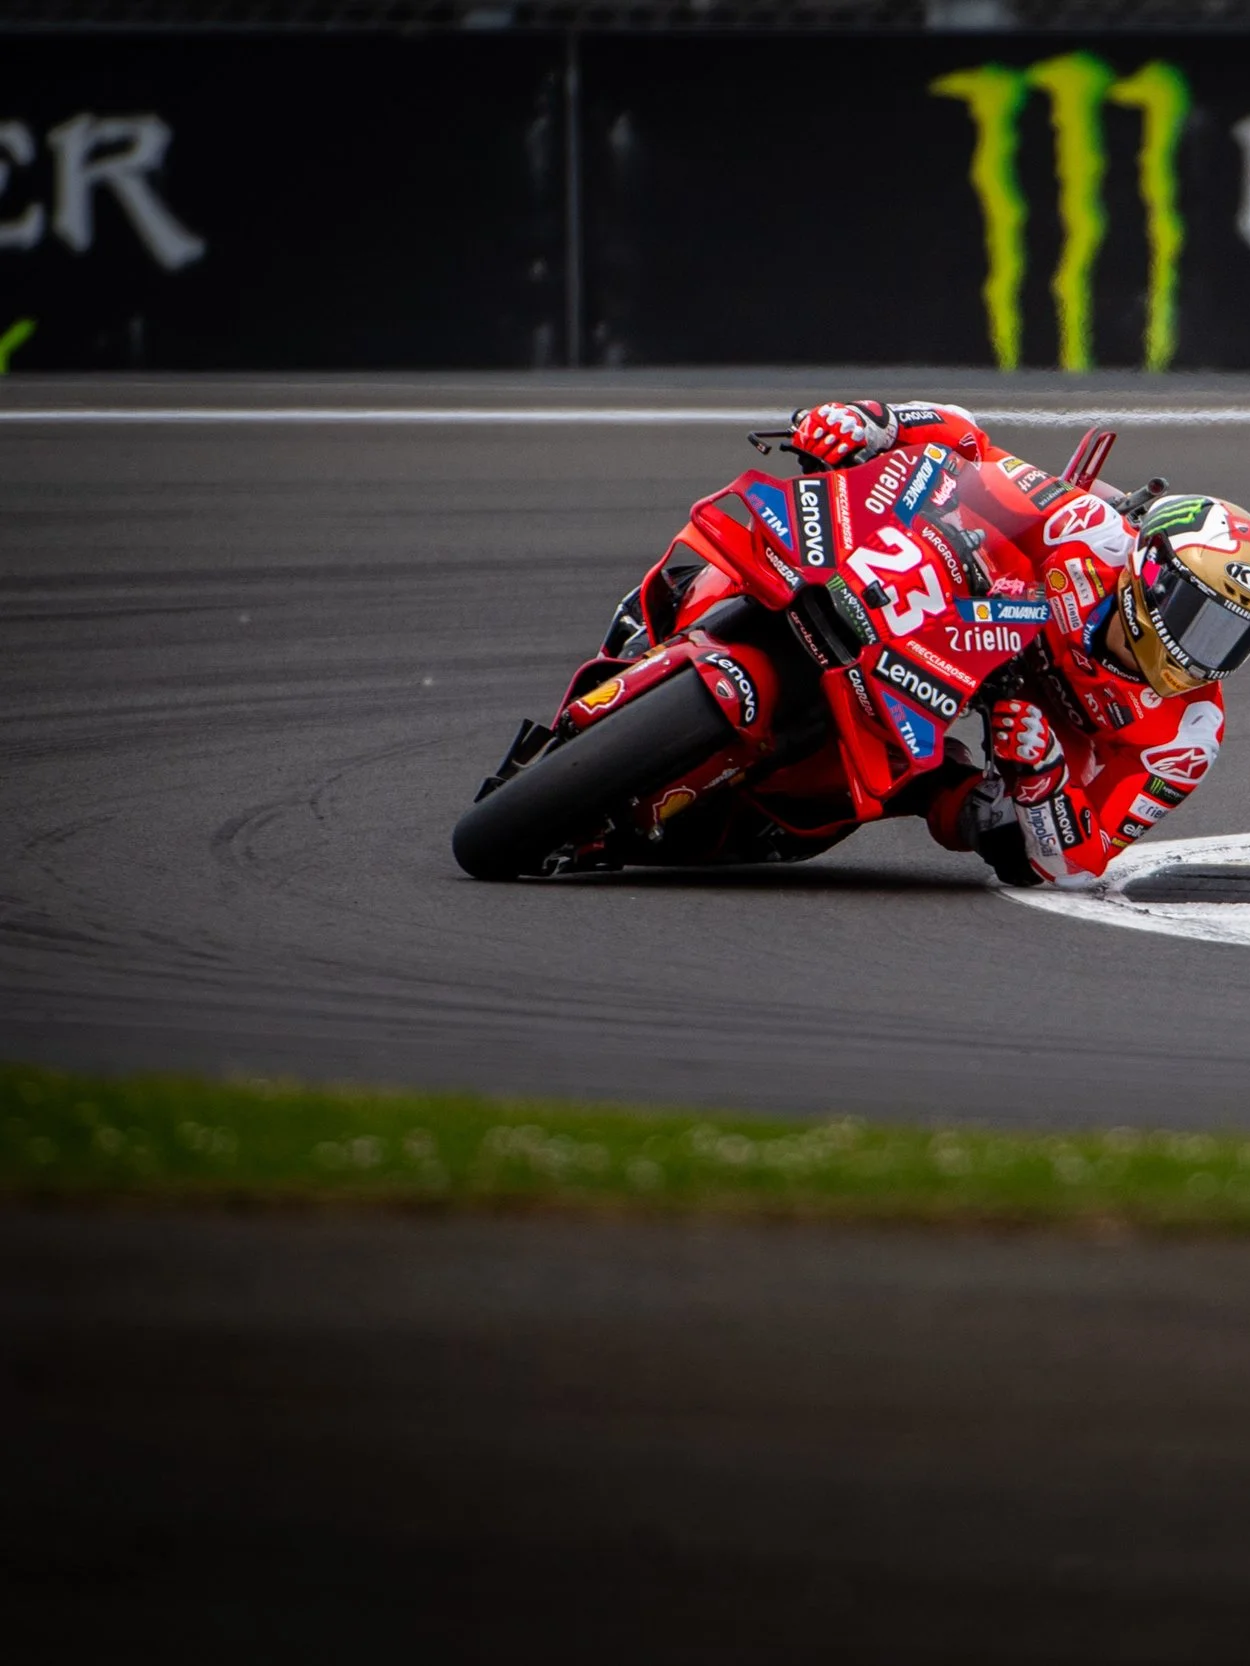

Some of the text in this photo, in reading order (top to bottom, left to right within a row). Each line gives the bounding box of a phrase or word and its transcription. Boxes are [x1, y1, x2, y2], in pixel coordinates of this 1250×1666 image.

[902, 458, 933, 510] ADVANCE
[761, 507, 788, 537] TIM
[799, 480, 825, 566] Lenovo
[837, 474, 853, 550] FRECCIAROSSA
[766, 547, 800, 587] CARRERA
[846, 526, 947, 636] 23
[921, 527, 963, 585] VARGROUP
[841, 588, 877, 644] MONSTER
[998, 604, 1048, 620] ADVANCE
[1083, 623, 1095, 645] TIM
[1123, 585, 1139, 636] Lenovo
[790, 611, 829, 665] aruba.it
[1150, 608, 1190, 667] TERRANOVA
[705, 652, 756, 722] Lenovo
[876, 651, 957, 716] Lenovo
[906, 640, 977, 688] FRECCIAROSSA
[1102, 659, 1139, 682] Lenovo
[900, 722, 920, 754] TIM
[1054, 794, 1076, 844] Lenovo
